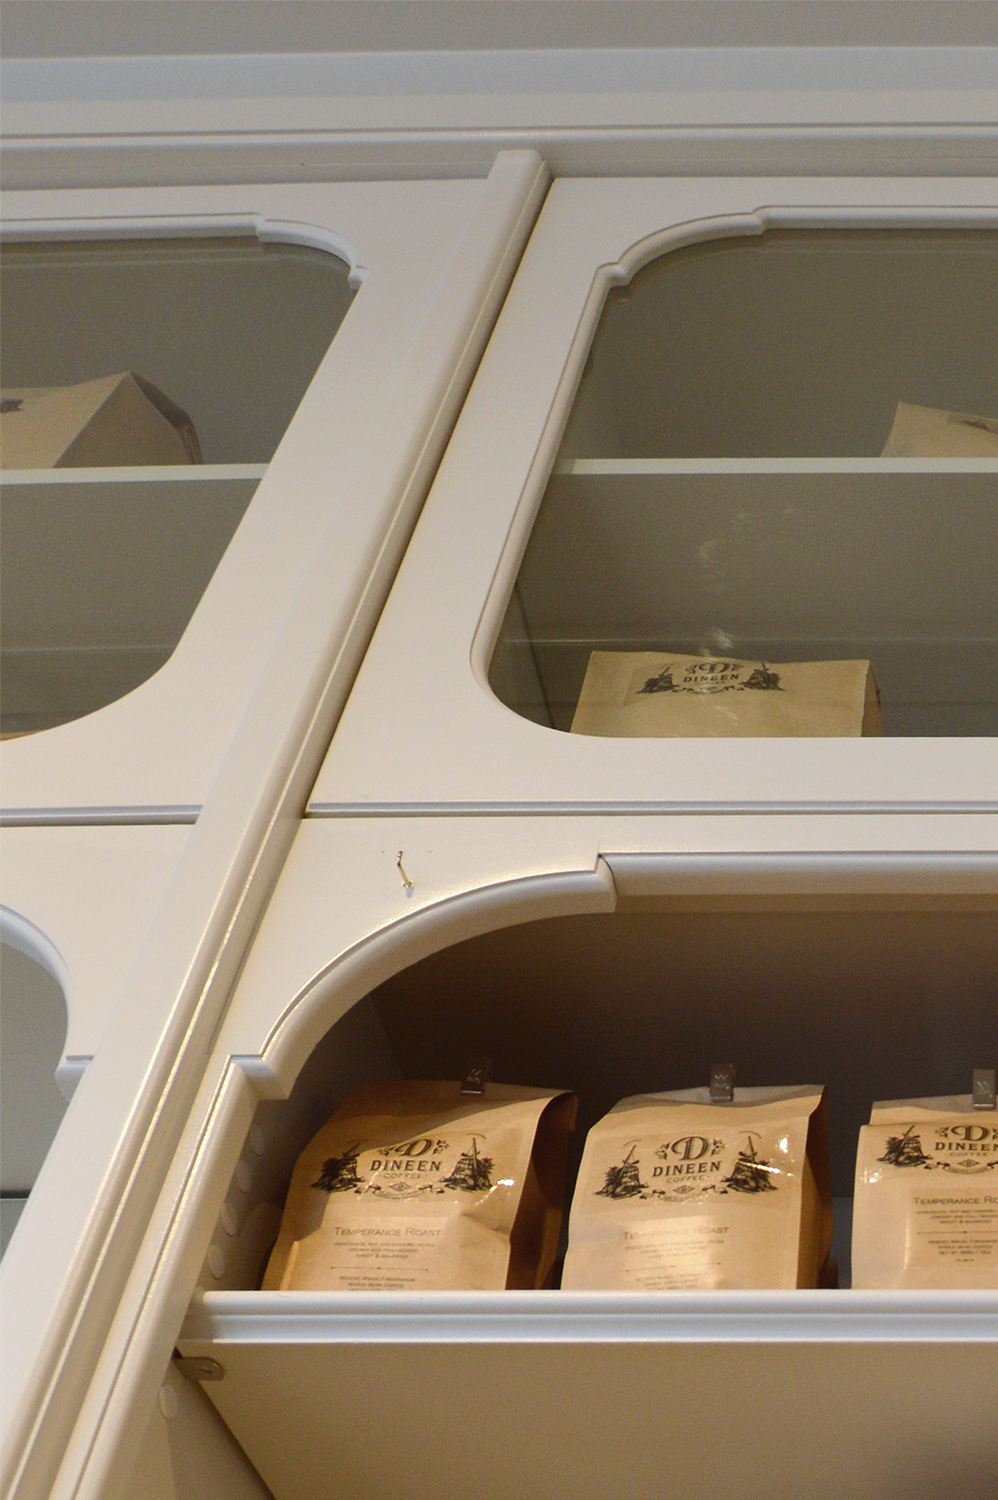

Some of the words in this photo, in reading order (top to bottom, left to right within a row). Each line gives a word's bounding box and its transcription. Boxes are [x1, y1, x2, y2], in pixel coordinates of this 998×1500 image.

[683, 674, 739, 683] DINEEN
[951, 1125, 990, 1142] D
[671, 1136, 710, 1161] D
[370, 1160, 443, 1172] DINEEN
[652, 1160, 722, 1177] DINEEN
[666, 1175, 706, 1183] COFFEE
[912, 1197, 980, 1205] TEMPERANCE
[334, 1227, 401, 1237] TEMPERANCE
[405, 1227, 442, 1237] ROAST
